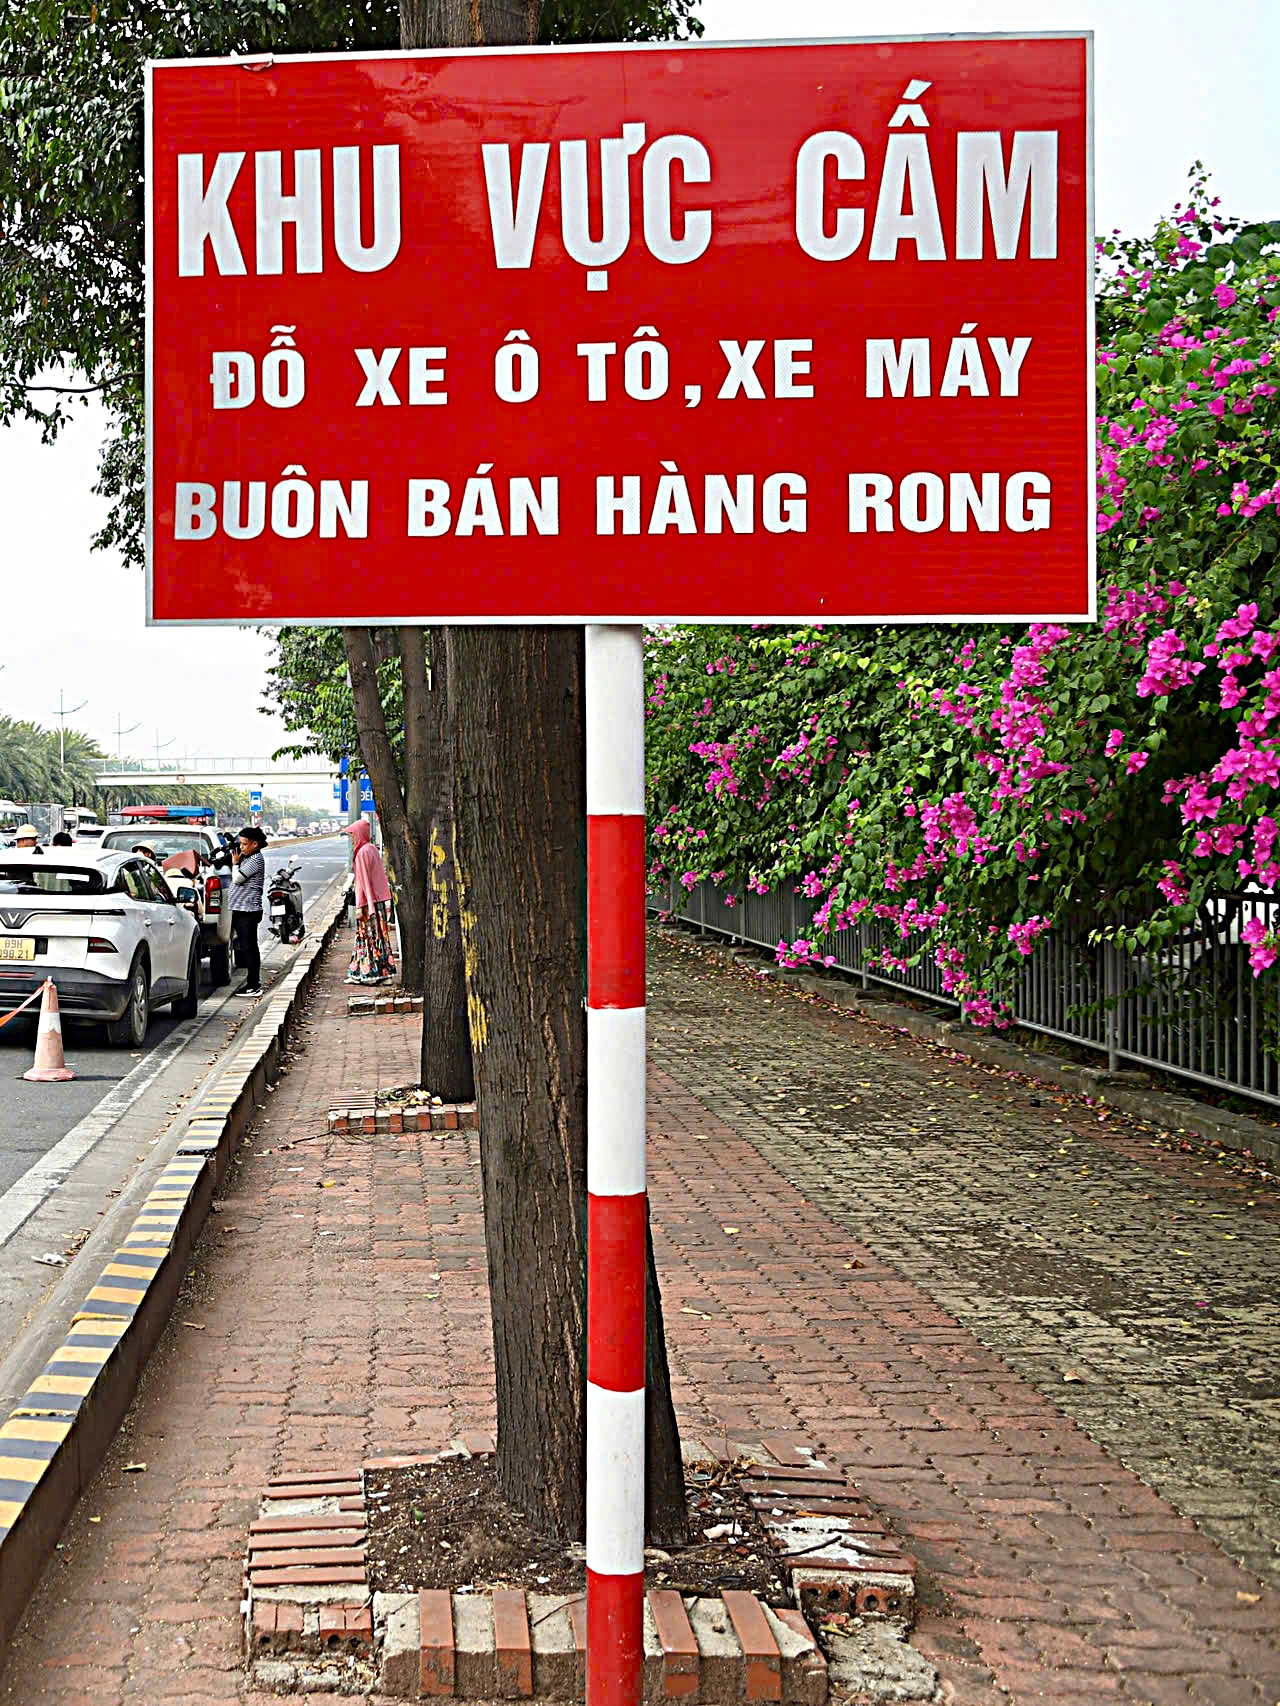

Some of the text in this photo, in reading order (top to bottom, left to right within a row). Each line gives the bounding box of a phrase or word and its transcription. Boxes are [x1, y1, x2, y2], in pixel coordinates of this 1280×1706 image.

[178, 79, 1059, 292] KHU VỰC CẤM
[210, 325, 305, 410] ĐỖ
[355, 347, 448, 407] XE
[495, 329, 539, 403] Ô
[866, 323, 1033, 398] MÁY
[175, 461, 1051, 541] BUÔN BÁN HÀNG RONG
